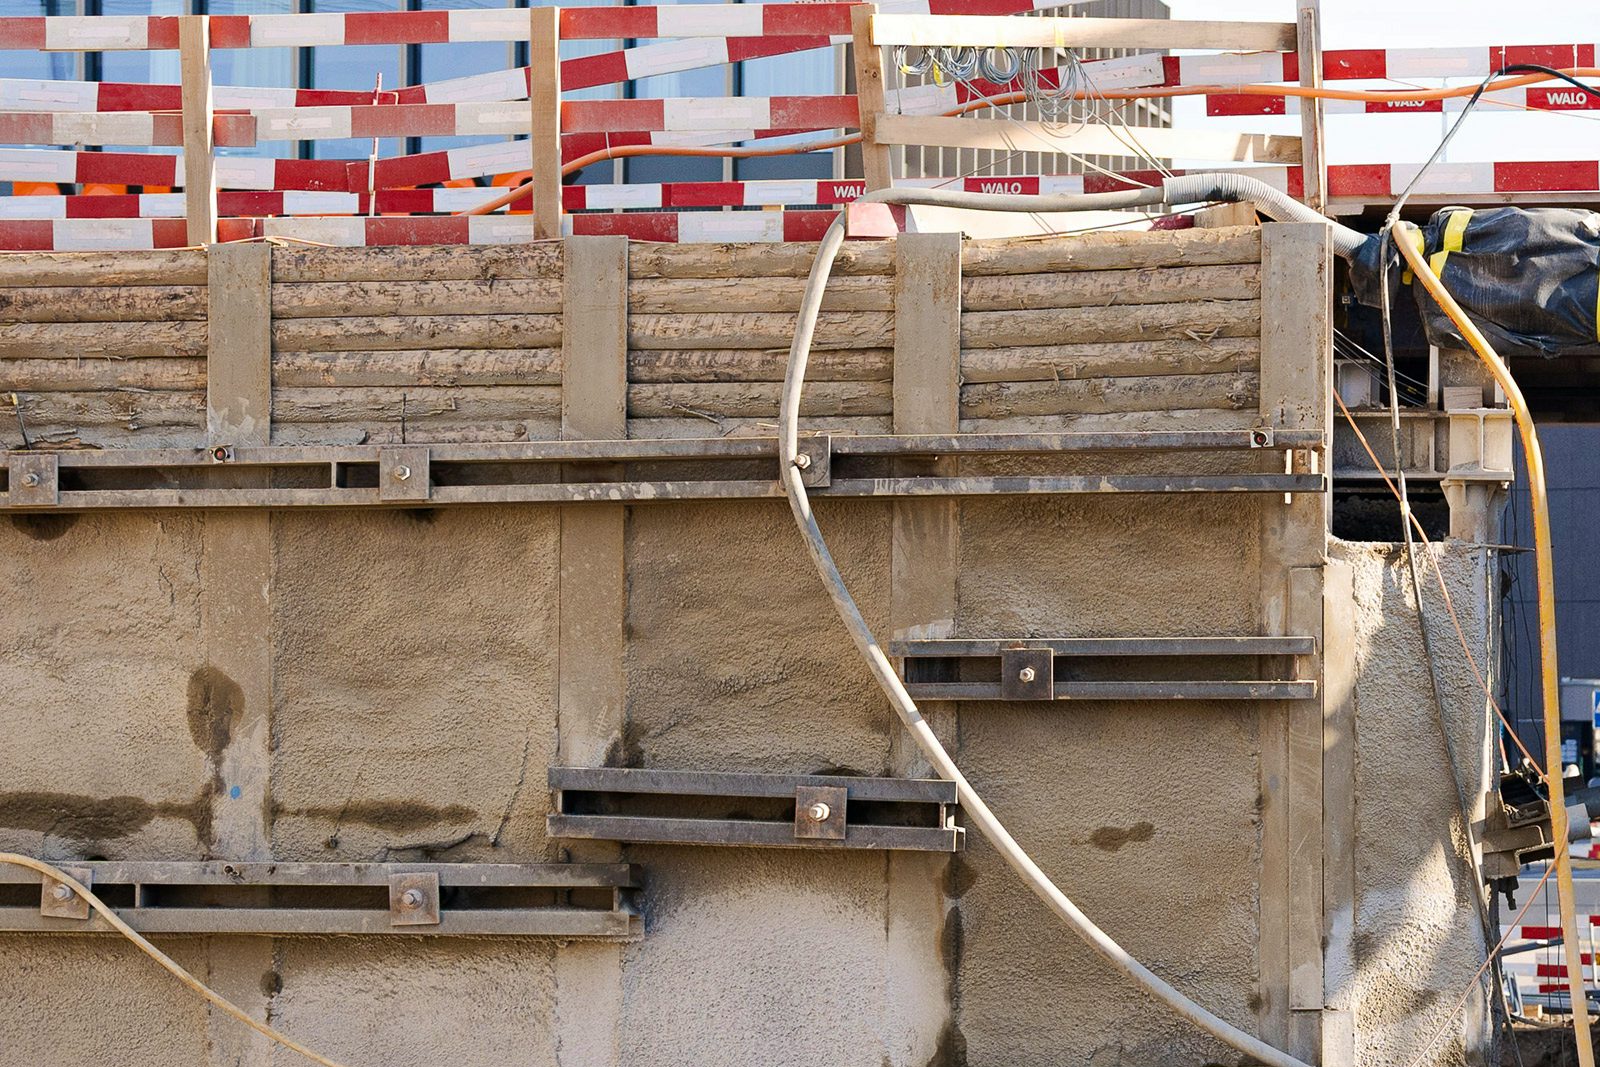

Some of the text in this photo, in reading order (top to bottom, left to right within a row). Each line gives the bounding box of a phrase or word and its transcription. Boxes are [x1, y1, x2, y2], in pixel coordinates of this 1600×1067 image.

[1546, 91, 1587, 105] WALO
[833, 185, 867, 199] WAL
[981, 181, 1022, 195] WALO
